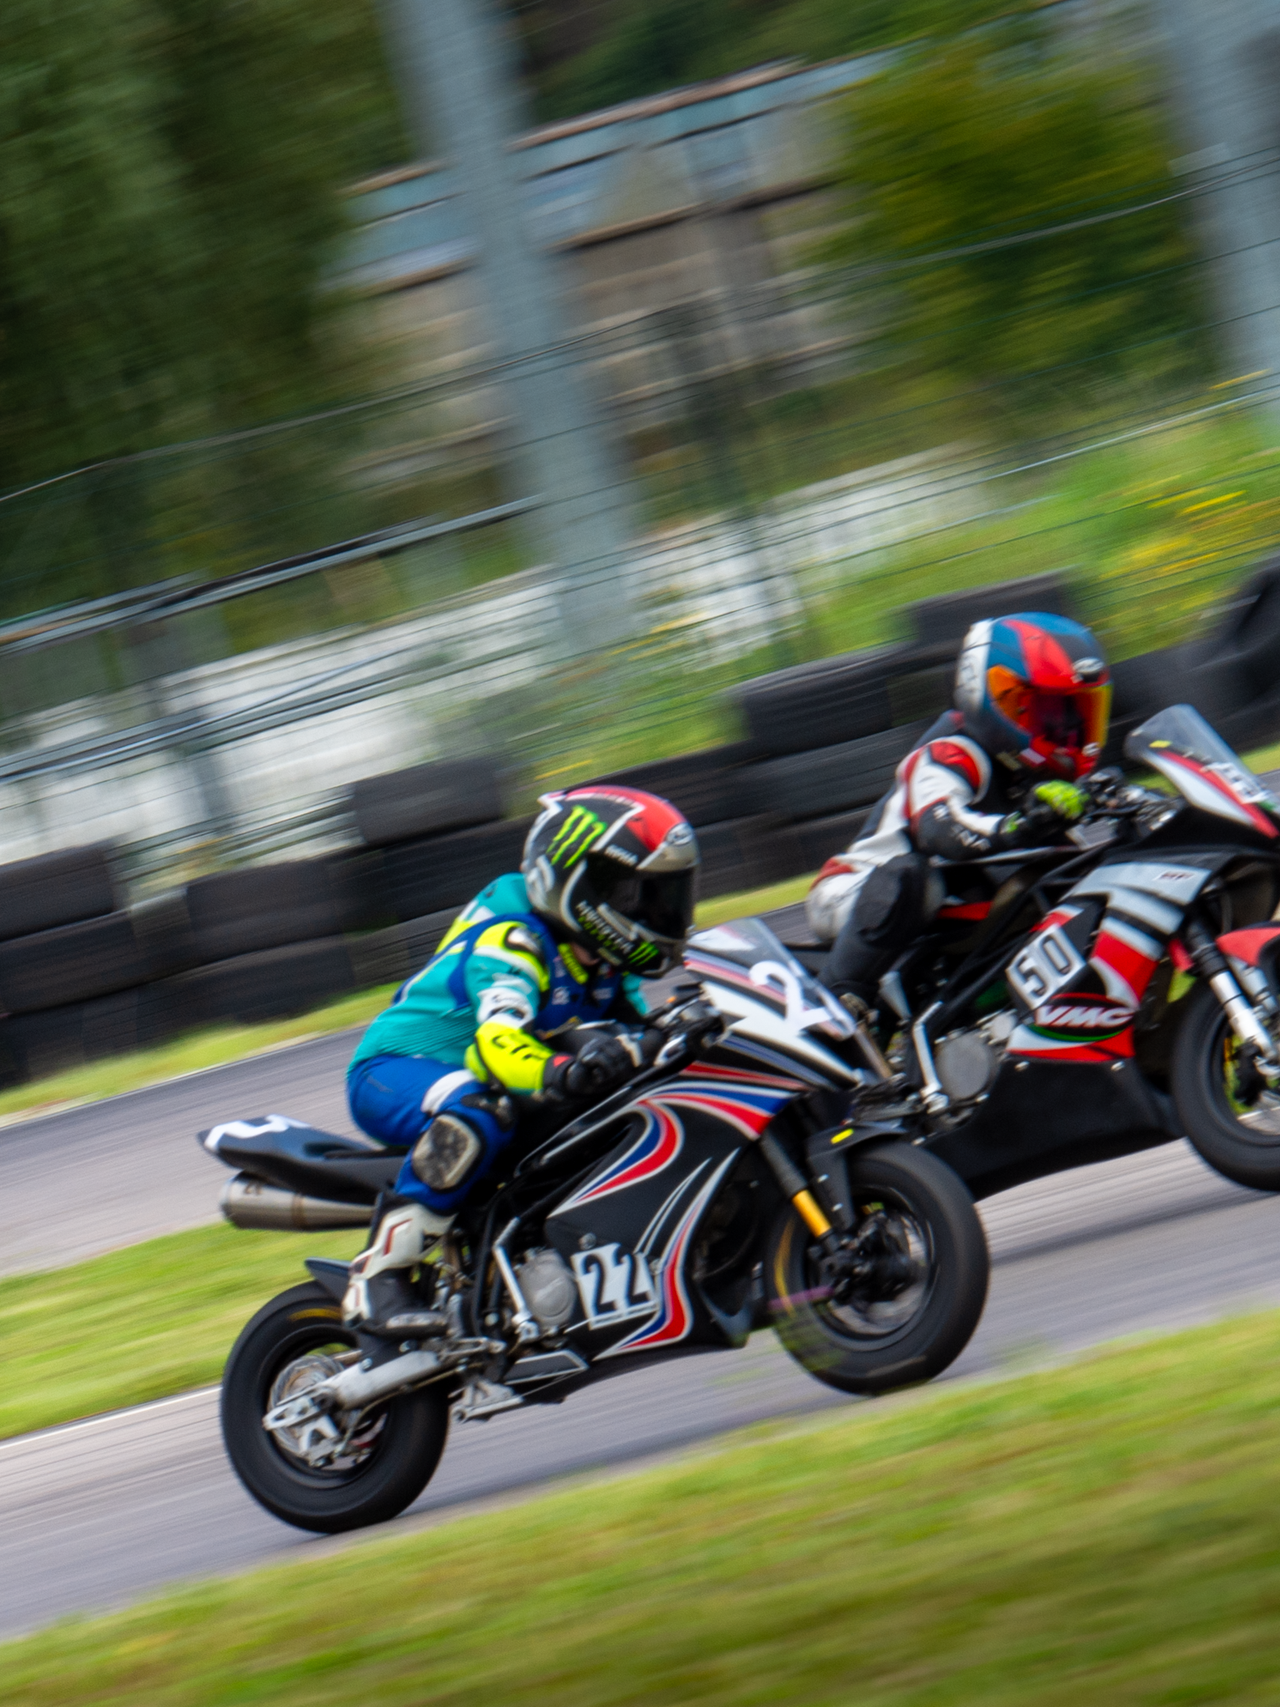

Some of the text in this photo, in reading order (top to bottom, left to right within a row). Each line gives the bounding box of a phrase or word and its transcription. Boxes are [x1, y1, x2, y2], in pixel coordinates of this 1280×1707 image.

[1015, 933, 1072, 998] 50
[1034, 1004, 1137, 1029] VMC
[581, 1243, 651, 1317] 22
